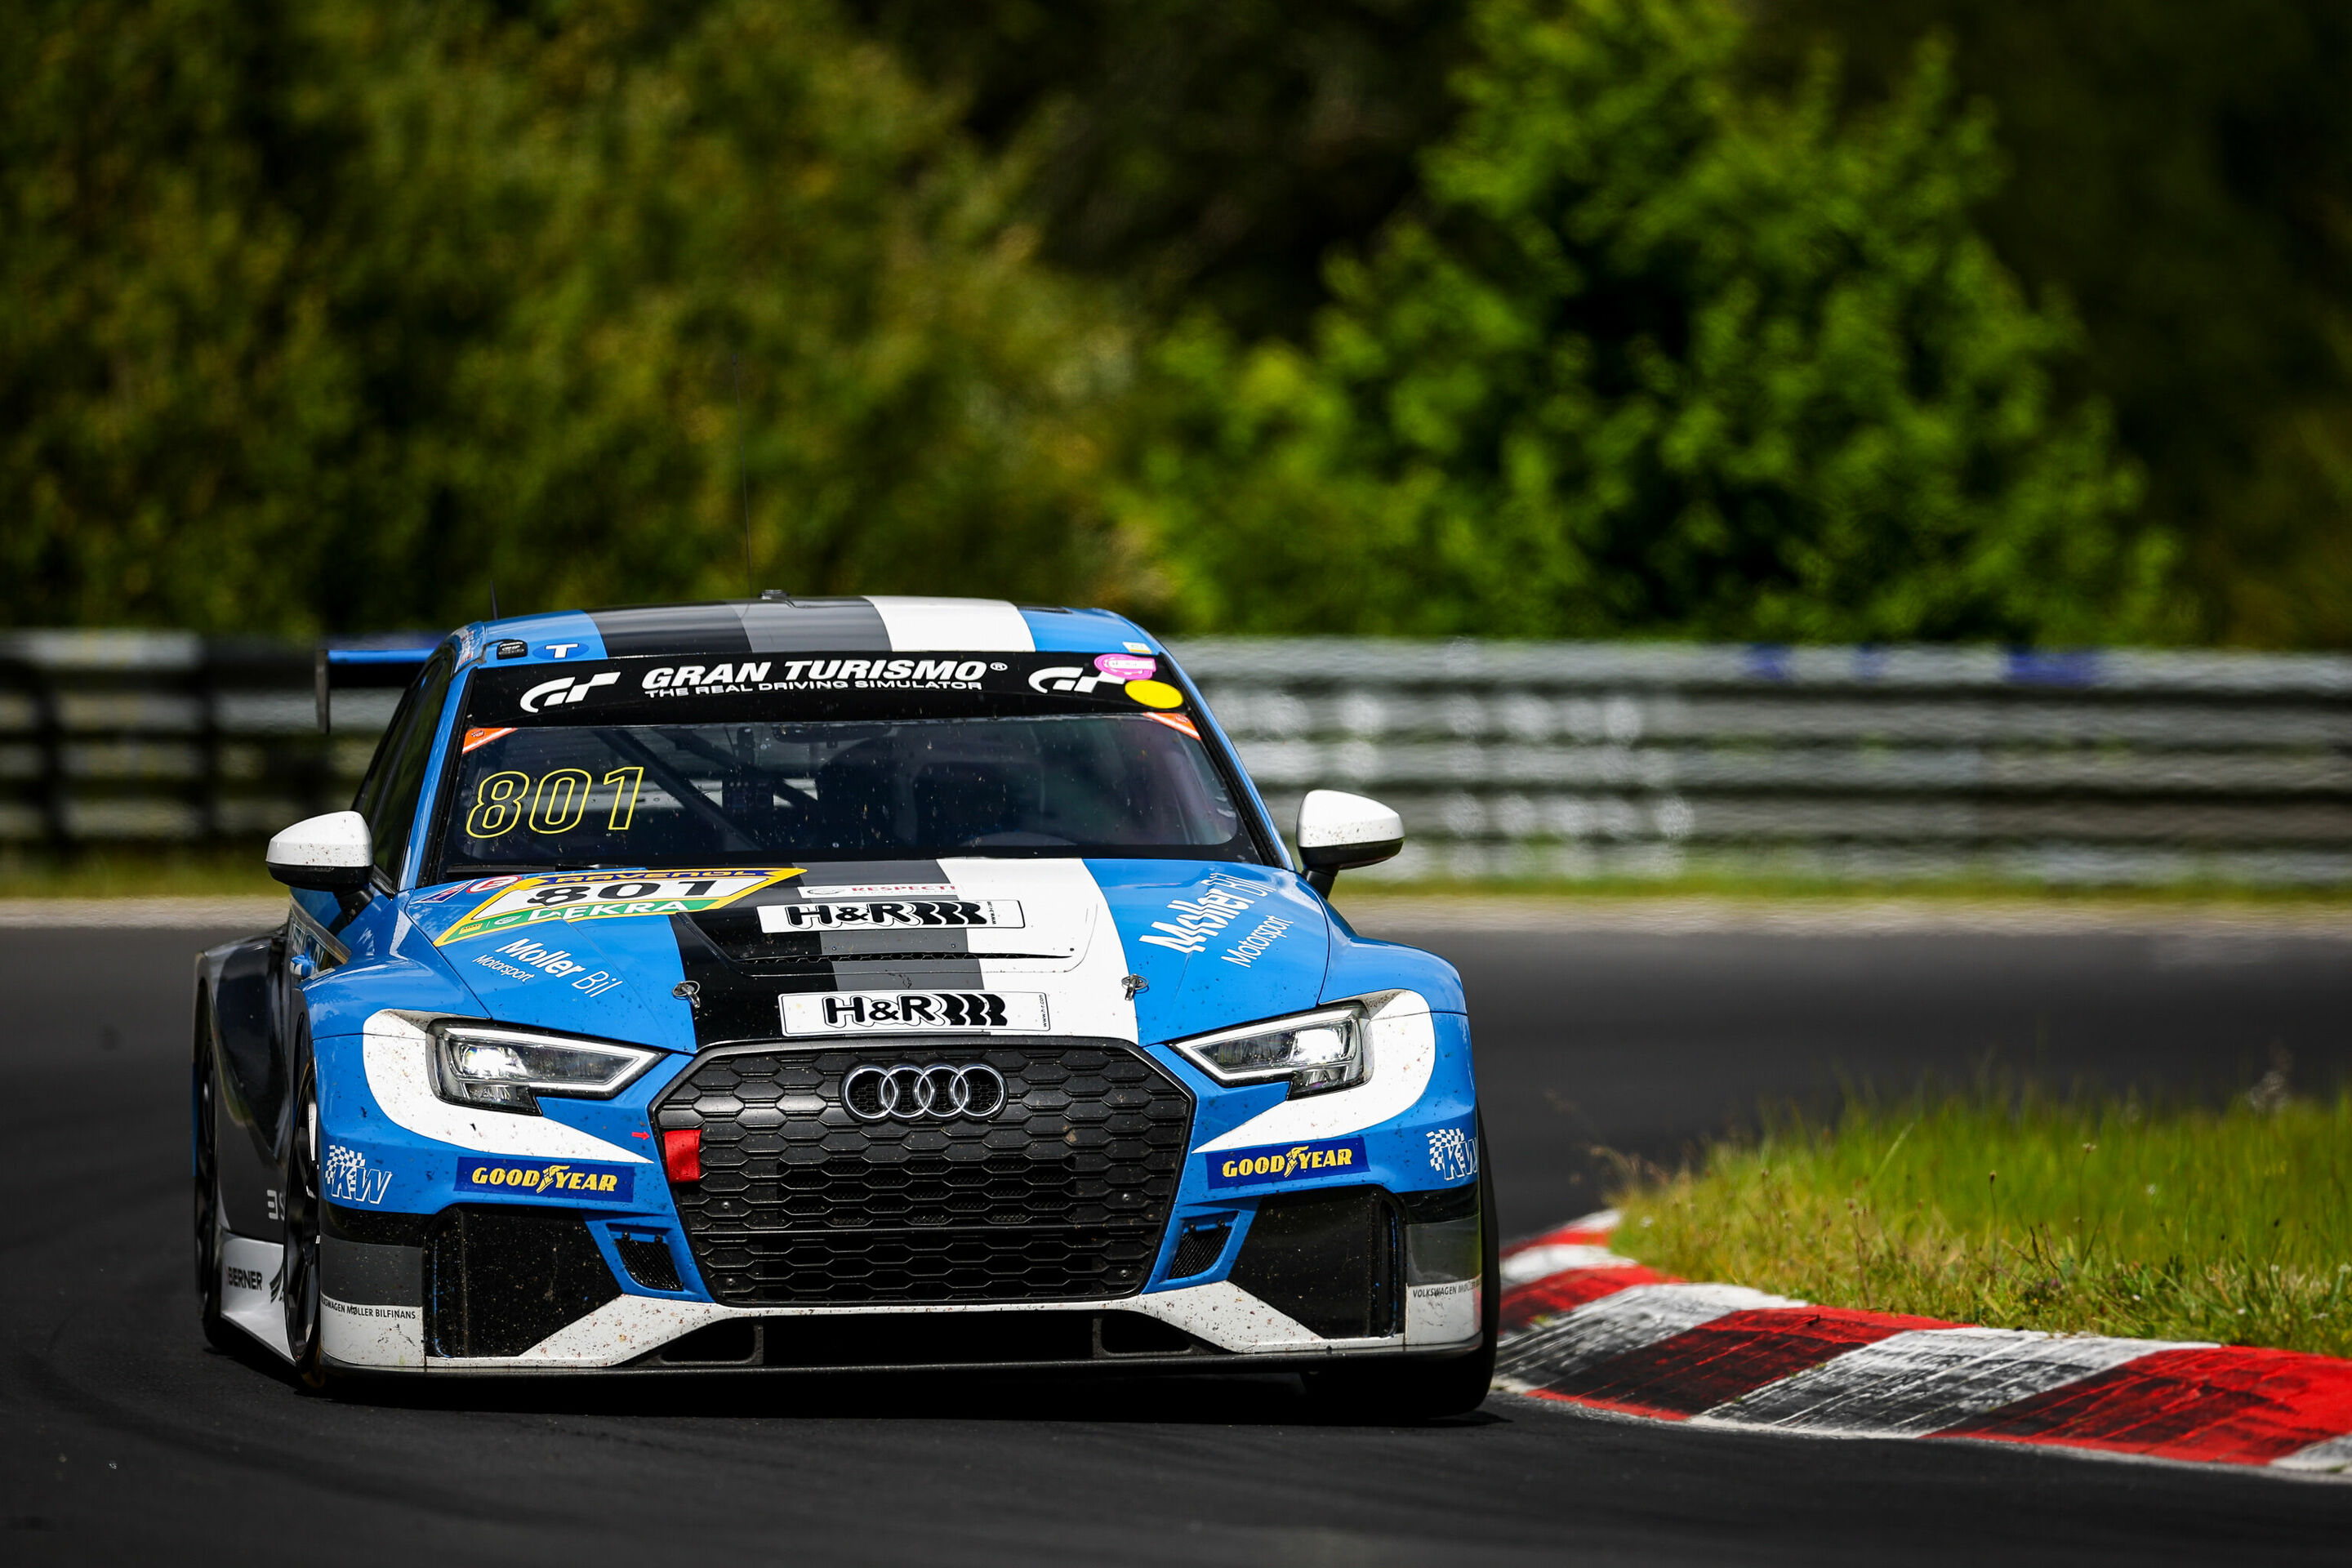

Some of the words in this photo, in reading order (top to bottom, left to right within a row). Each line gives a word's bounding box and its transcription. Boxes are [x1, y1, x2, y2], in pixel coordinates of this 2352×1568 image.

[546, 644, 579, 659] T
[642, 661, 772, 689] GRAN
[645, 686, 688, 698] THE
[696, 684, 753, 694] REAL
[759, 680, 849, 692] DRIVING
[854, 680, 982, 690] SIMULATOR
[466, 766, 644, 839] 801
[555, 871, 749, 884] RAVENOL
[527, 880, 717, 906] 801
[527, 901, 689, 921] DEKRA
[1221, 915, 1294, 968] Motorsport
[472, 954, 535, 982] Motorsport
[572, 970, 623, 997] Bil
[228, 1267, 263, 1291] BERNER
[1413, 1285, 1457, 1298] VOLKSWAGEN
[376, 1308, 416, 1320] BILFINANS
